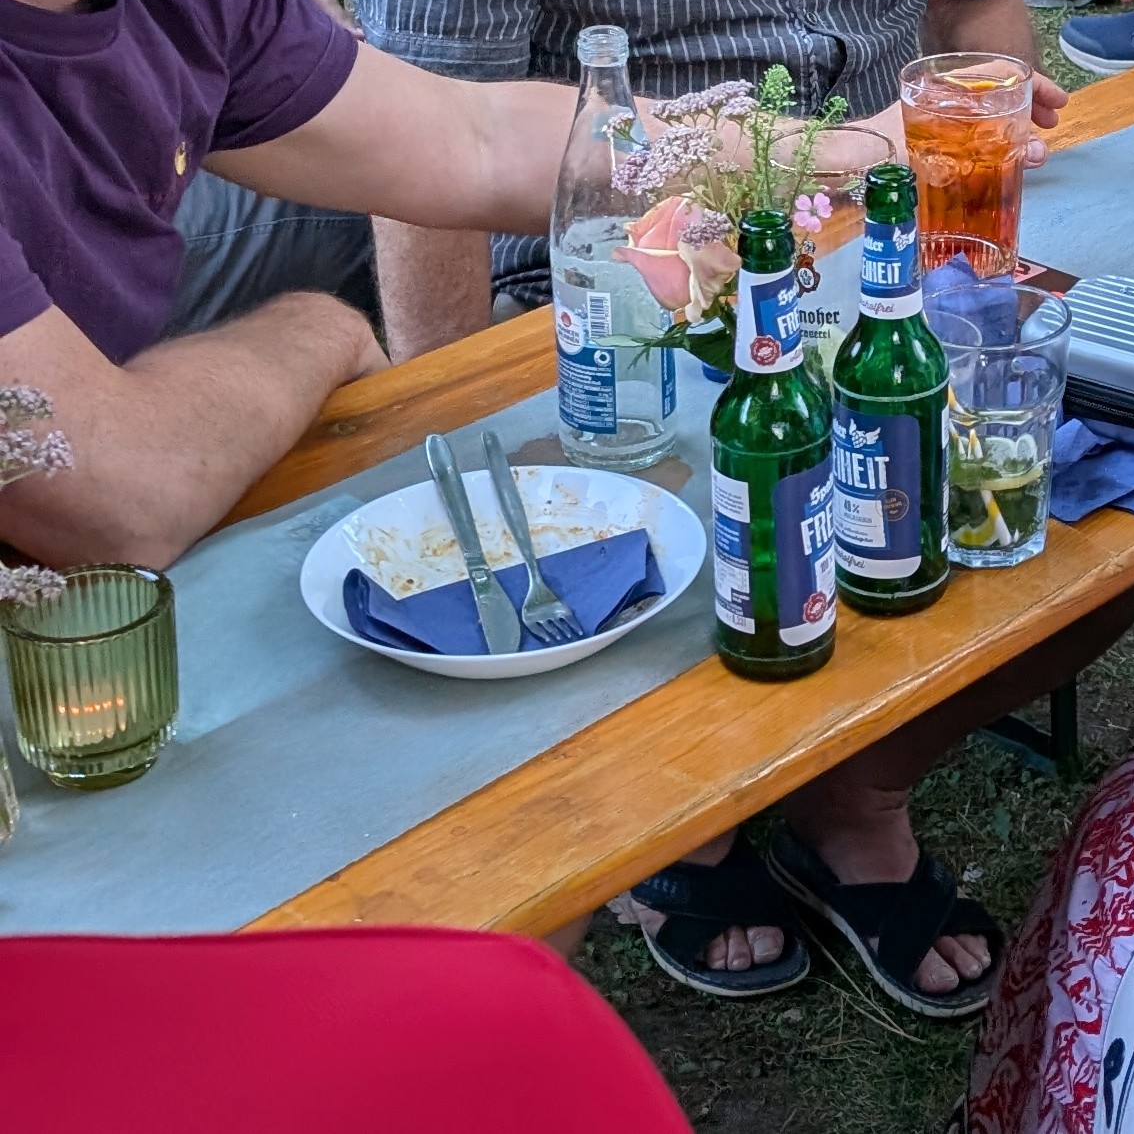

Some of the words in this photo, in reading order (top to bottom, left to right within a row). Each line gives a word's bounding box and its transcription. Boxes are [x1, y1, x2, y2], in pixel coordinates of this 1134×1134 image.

[862, 256, 901, 284] EIHEIT
[777, 309, 799, 339] FRE
[833, 440, 889, 491] EIHEIT
[801, 501, 833, 556] FRE
